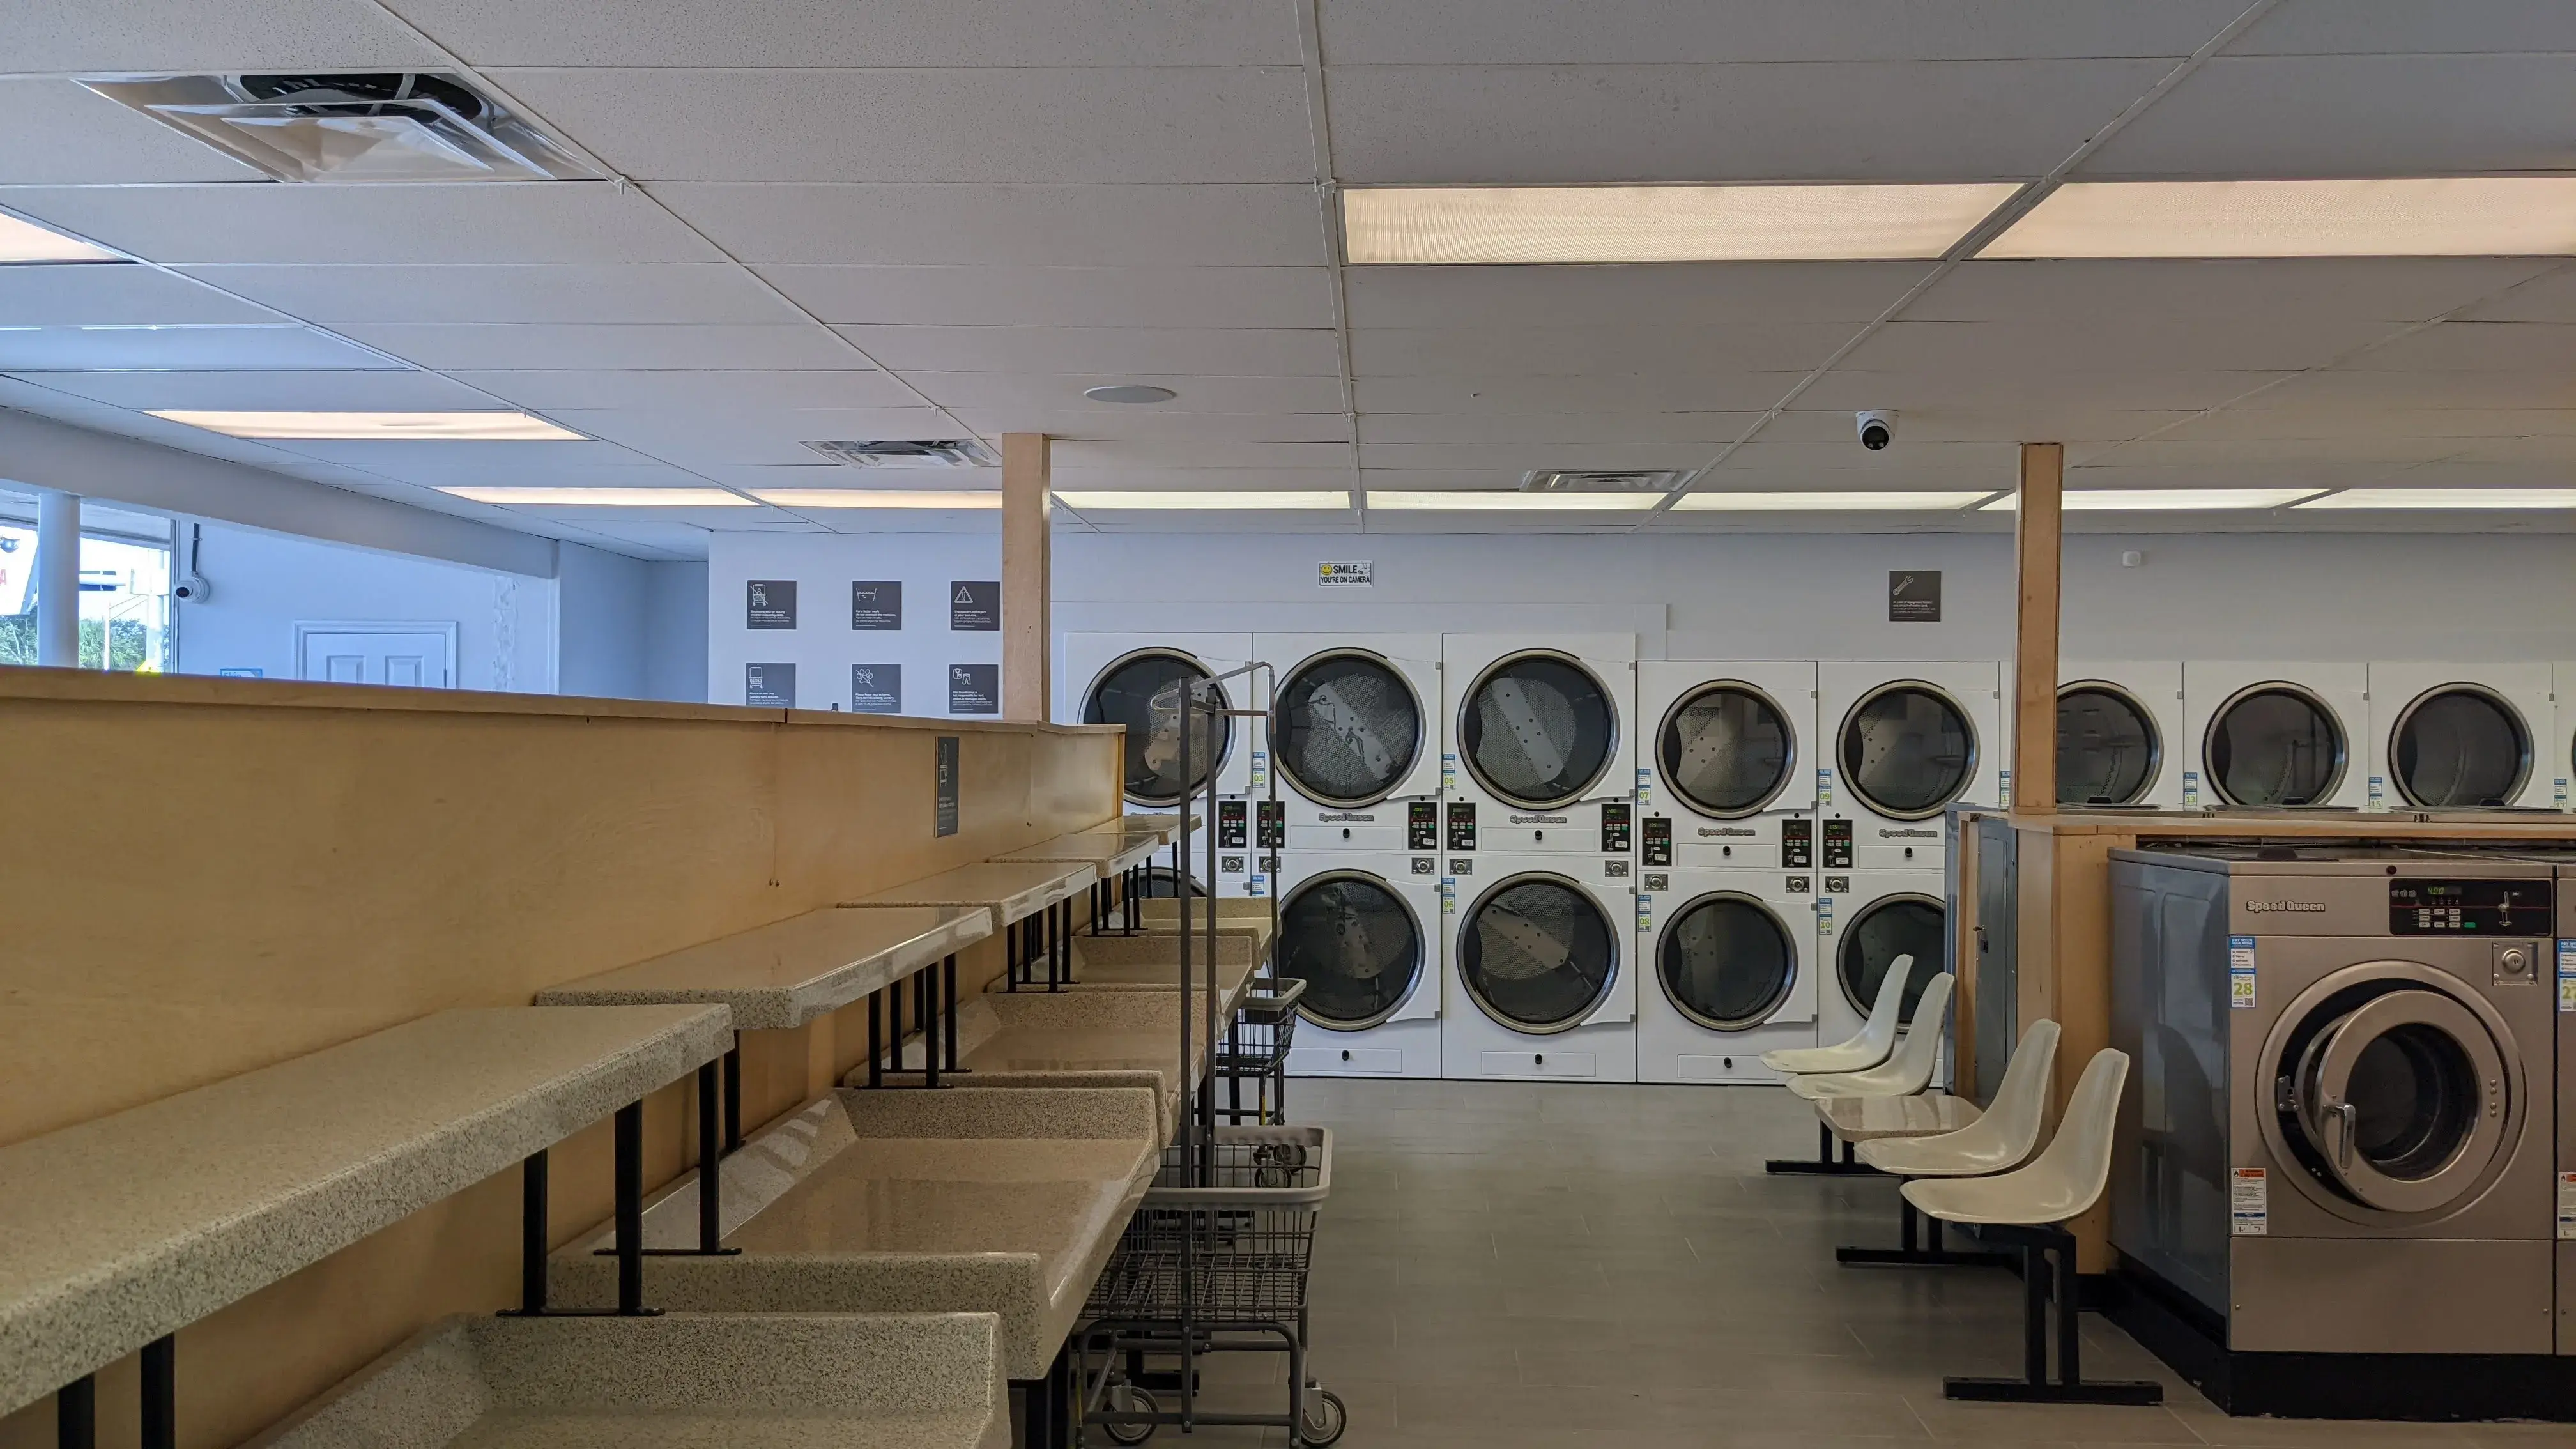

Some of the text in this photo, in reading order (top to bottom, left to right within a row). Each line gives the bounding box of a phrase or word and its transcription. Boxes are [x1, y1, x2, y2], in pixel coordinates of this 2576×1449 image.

[1333, 565, 1357, 574] SMILE
[1319, 813, 1346, 822] Speed
[1510, 815, 1567, 824] Speed Queen
[1698, 827, 1726, 837] Speed
[1879, 829, 1938, 838] Speed Queen
[2246, 900, 2326, 913] Speed Queen
[2233, 983, 2253, 995] 28
